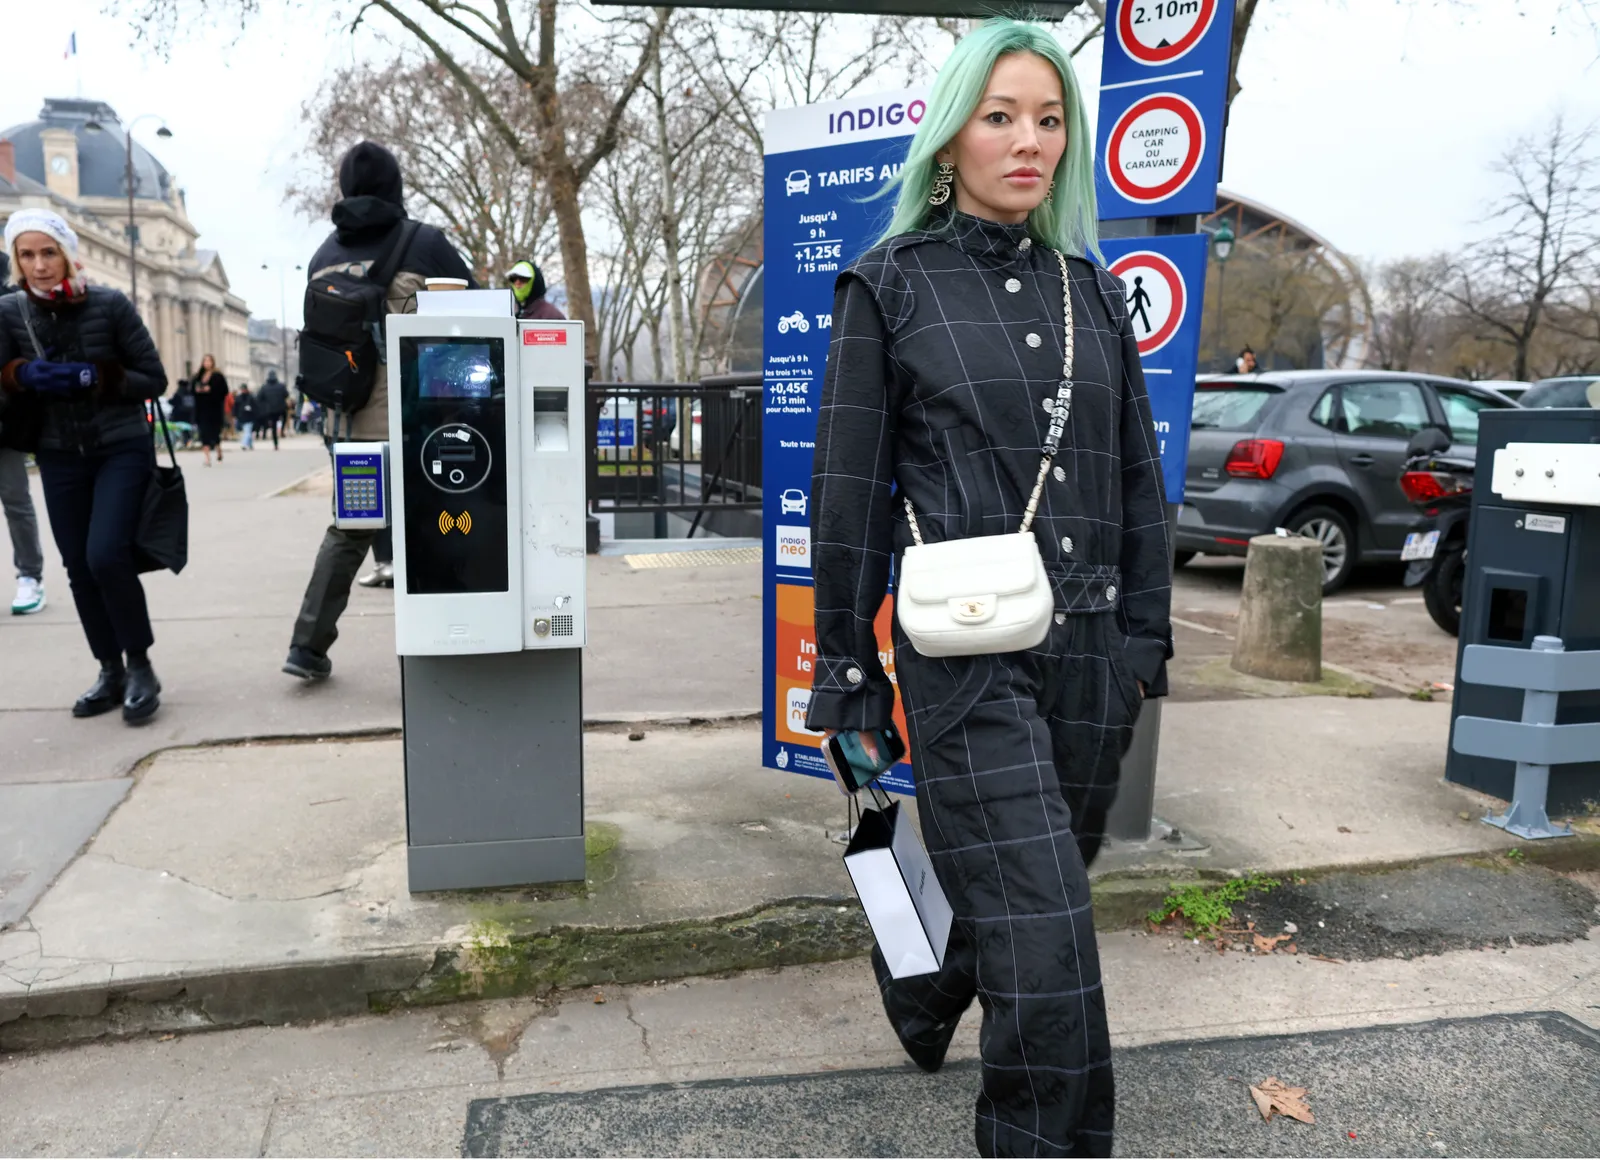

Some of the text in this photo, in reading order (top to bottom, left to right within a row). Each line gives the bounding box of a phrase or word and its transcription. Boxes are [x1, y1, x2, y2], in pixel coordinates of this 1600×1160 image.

[1134, 0, 1198, 24] 2.10m
[829, 100, 926, 134] INDIGO
[1132, 126, 1179, 139] CAMPING
[1144, 138, 1164, 147] CAR
[1146, 149, 1160, 158] OU
[1125, 158, 1179, 170] CARAVANE
[818, 167, 874, 187] TARIFS
[799, 211, 837, 224] Jusqu'à
[810, 228, 826, 239] 9 h
[795, 245, 842, 261] +1,25€
[804, 263, 816, 273] 15
[818, 261, 838, 272] min
[769, 354, 809, 364] Jusqu'à 9 h
[769, 382, 809, 396] +0,45€
[788, 396, 806, 404] min
[782, 406, 805, 414] chaque
[780, 440, 798, 448] Toute
[780, 537, 807, 545] INDIGO
[780, 544, 807, 555] neo
[800, 638, 817, 654] In
[797, 655, 812, 672] le
